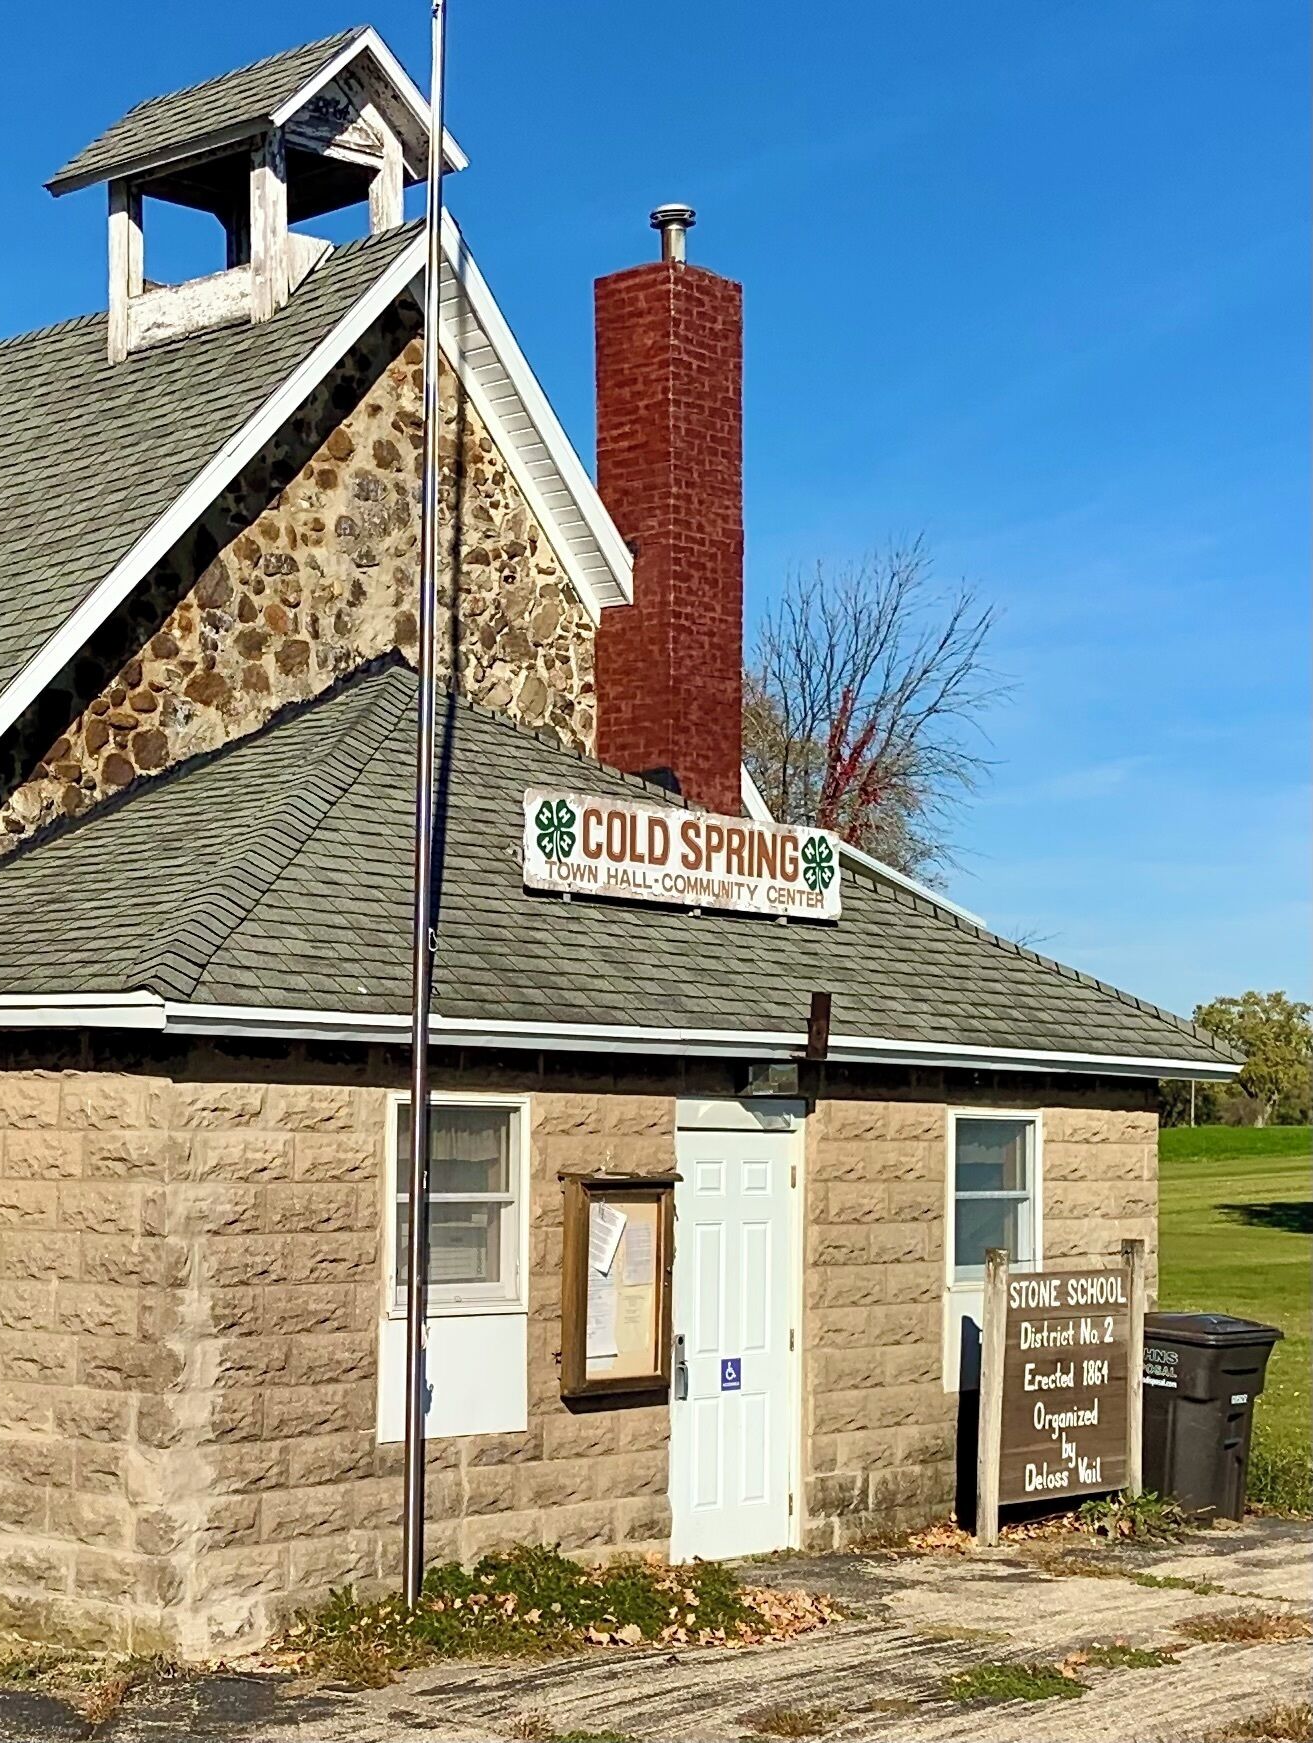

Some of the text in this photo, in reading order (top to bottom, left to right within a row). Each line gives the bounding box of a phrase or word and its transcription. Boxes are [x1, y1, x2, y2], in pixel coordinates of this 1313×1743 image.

[583, 808, 798, 883] COLD SPRING
[545, 860, 598, 884] TOWN
[767, 885, 824, 910] CENTER
[1009, 1277, 1127, 1309] STONE SCHOOL
[1020, 1315, 1114, 1350] District No. 2
[1143, 1347, 1179, 1365] HNS
[1143, 1363, 1178, 1378] OSAL
[1024, 1359, 1108, 1391] Erected 1864
[1033, 1397, 1098, 1440] Organized
[1061, 1432, 1077, 1469] by
[1025, 1456, 1102, 1492] Deloss Vail
